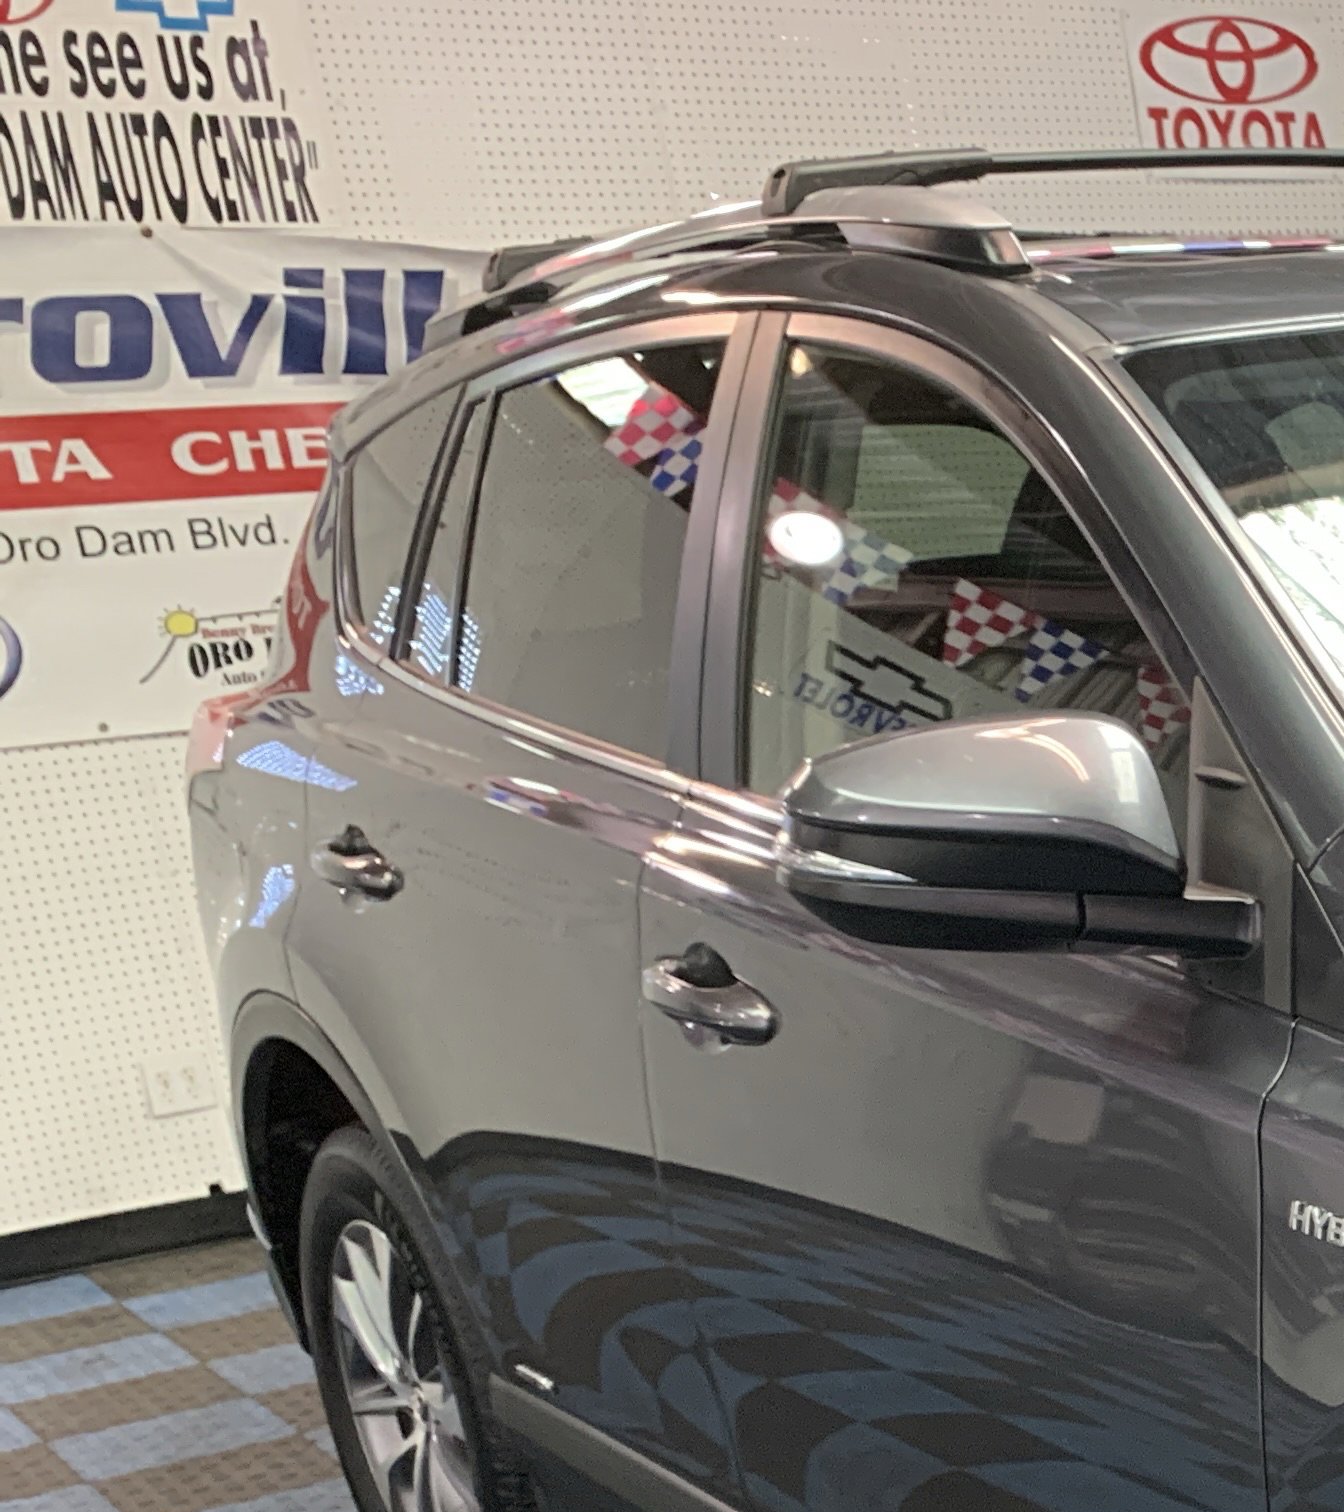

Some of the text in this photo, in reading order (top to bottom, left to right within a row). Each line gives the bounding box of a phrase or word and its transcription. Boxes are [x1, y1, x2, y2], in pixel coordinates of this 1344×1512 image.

[63, 30, 147, 99] see
[157, 34, 214, 101] us
[1147, 107, 1327, 149] TOYOTA
[87, 110, 188, 224] AUTO
[0, 427, 331, 484] TA CHE
[76, 525, 175, 558] Dam
[188, 514, 290, 549] Blvd.
[202, 626, 246, 639] Benny
[188, 637, 254, 679] ORO
[221, 672, 258, 686] Auto
